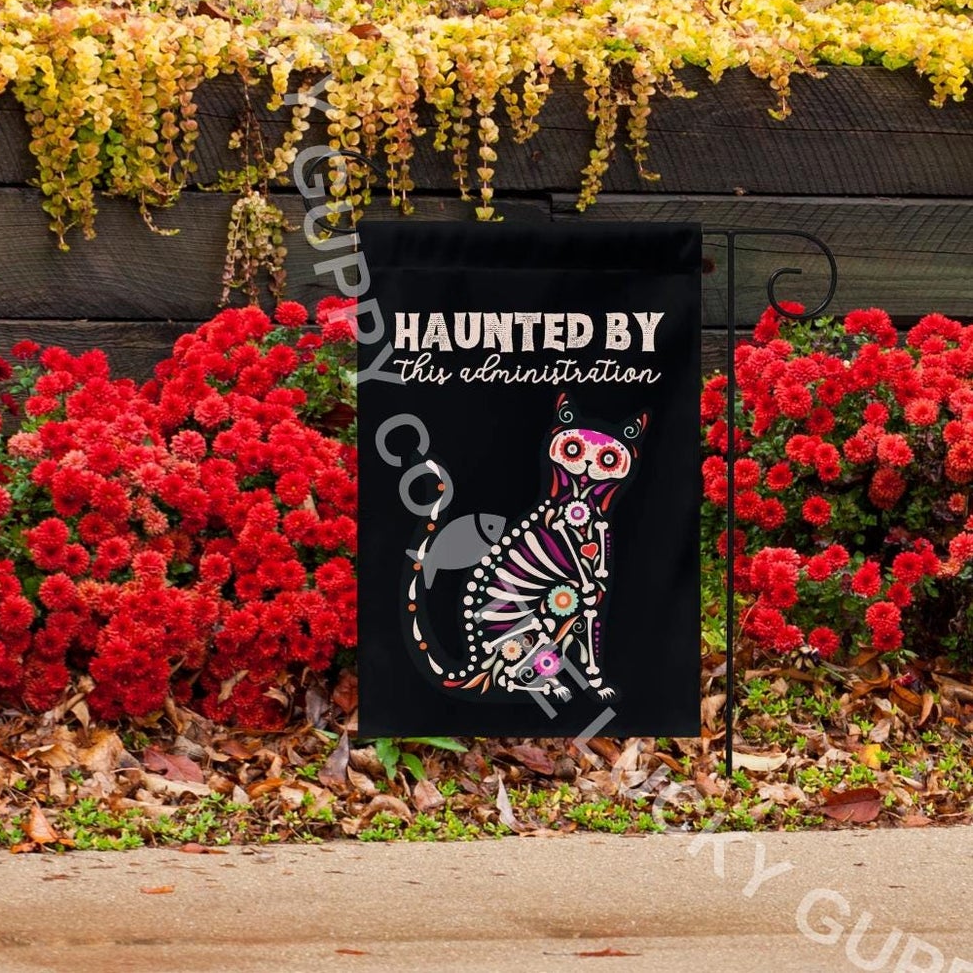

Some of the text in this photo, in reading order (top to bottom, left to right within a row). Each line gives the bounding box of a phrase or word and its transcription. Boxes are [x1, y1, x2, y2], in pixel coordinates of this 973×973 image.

[394, 311, 665, 353] HAUNTED BY
[393, 352, 662, 385] this administration
